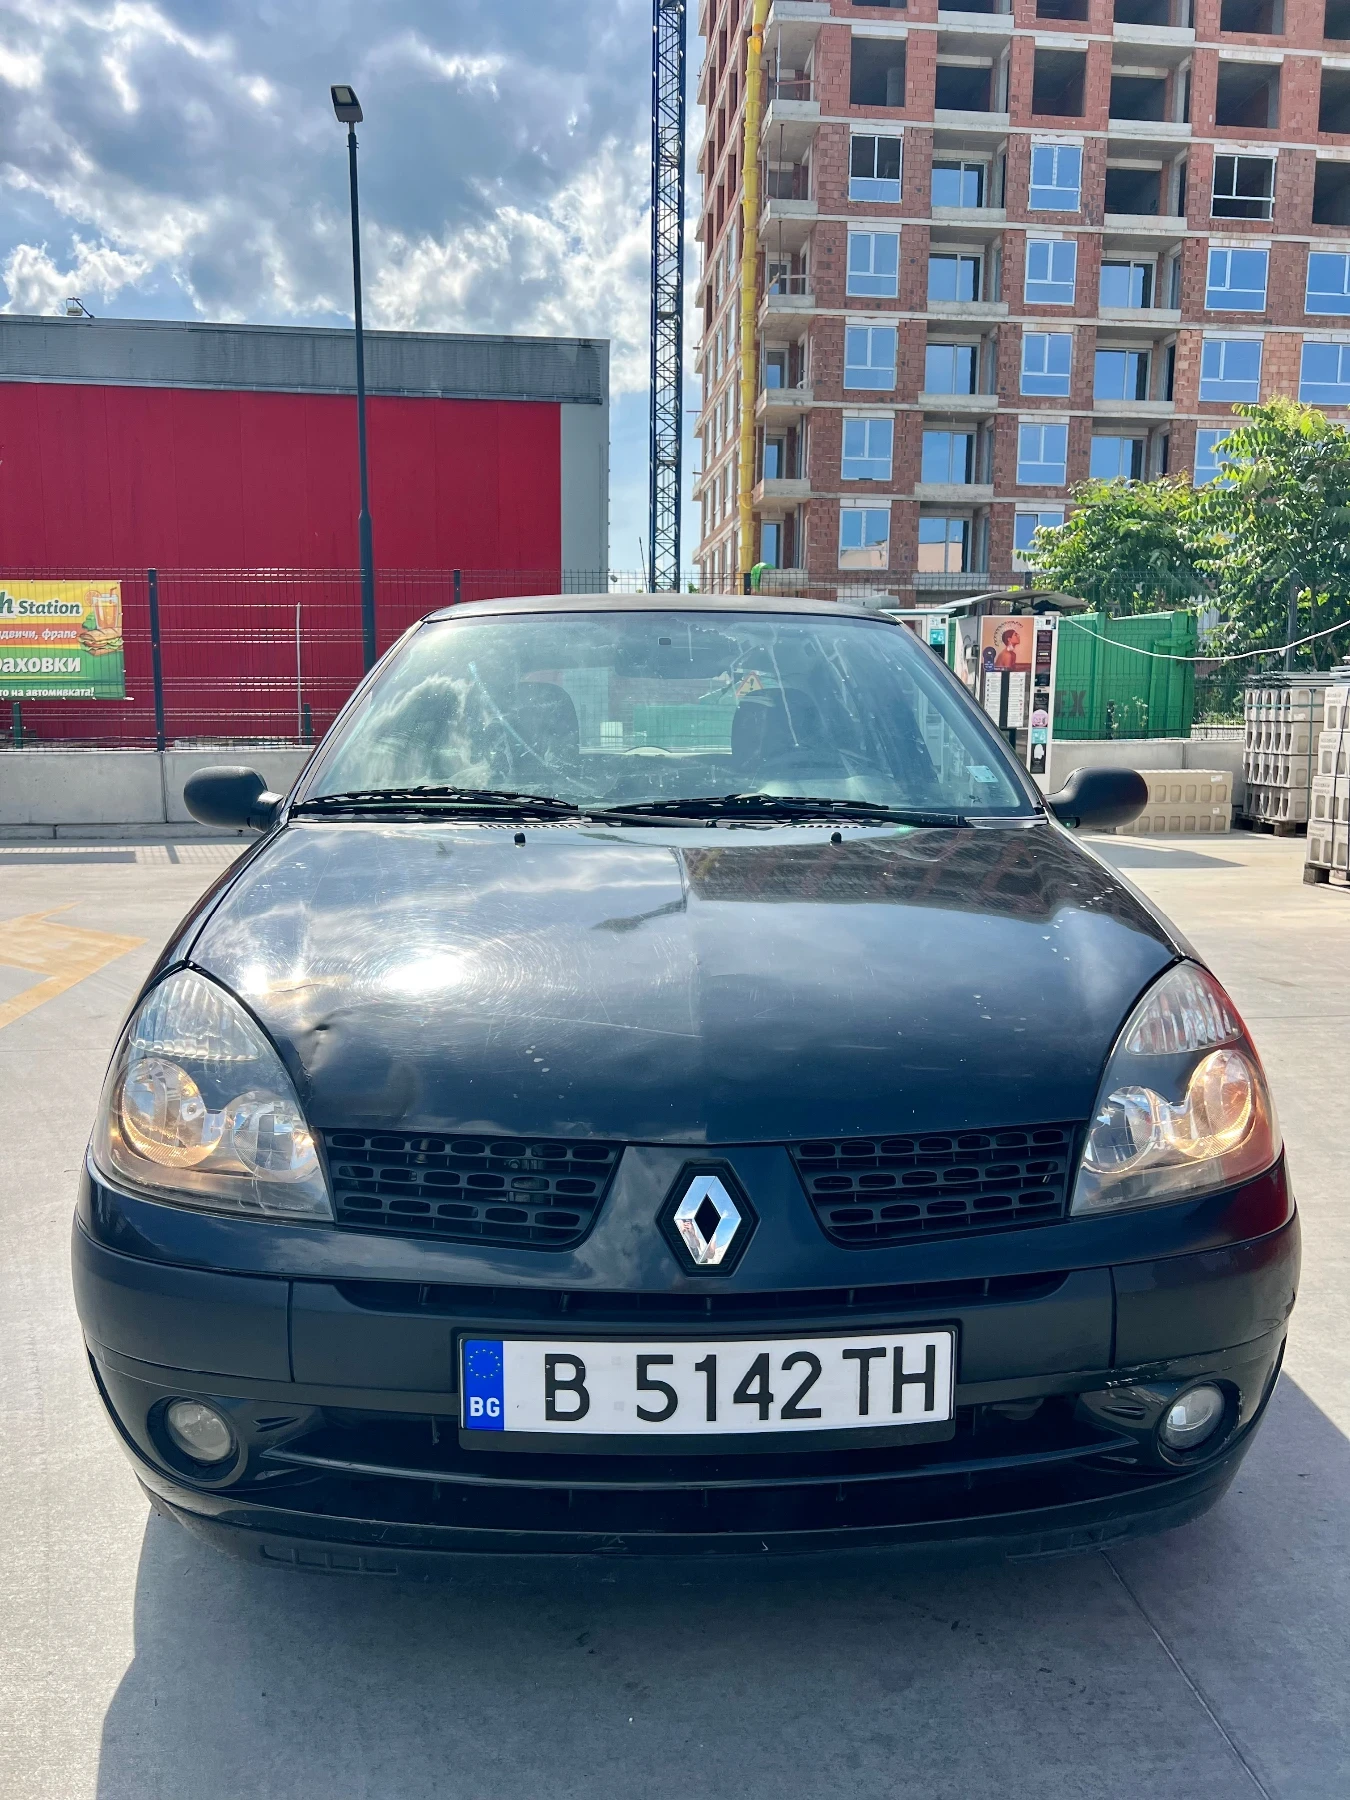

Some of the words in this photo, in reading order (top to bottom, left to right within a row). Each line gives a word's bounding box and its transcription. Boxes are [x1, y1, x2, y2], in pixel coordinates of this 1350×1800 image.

[18, 600, 80, 615] Station
[0, 630, 38, 640] двичи,
[41, 628, 77, 640] фрапе
[11, 689, 24, 697] на
[26, 687, 94, 697] автомивката!
[470, 1396, 500, 1417] BG
[544, 1353, 591, 1422] B
[636, 1350, 823, 1423] 5142
[842, 1344, 937, 1417] TH
